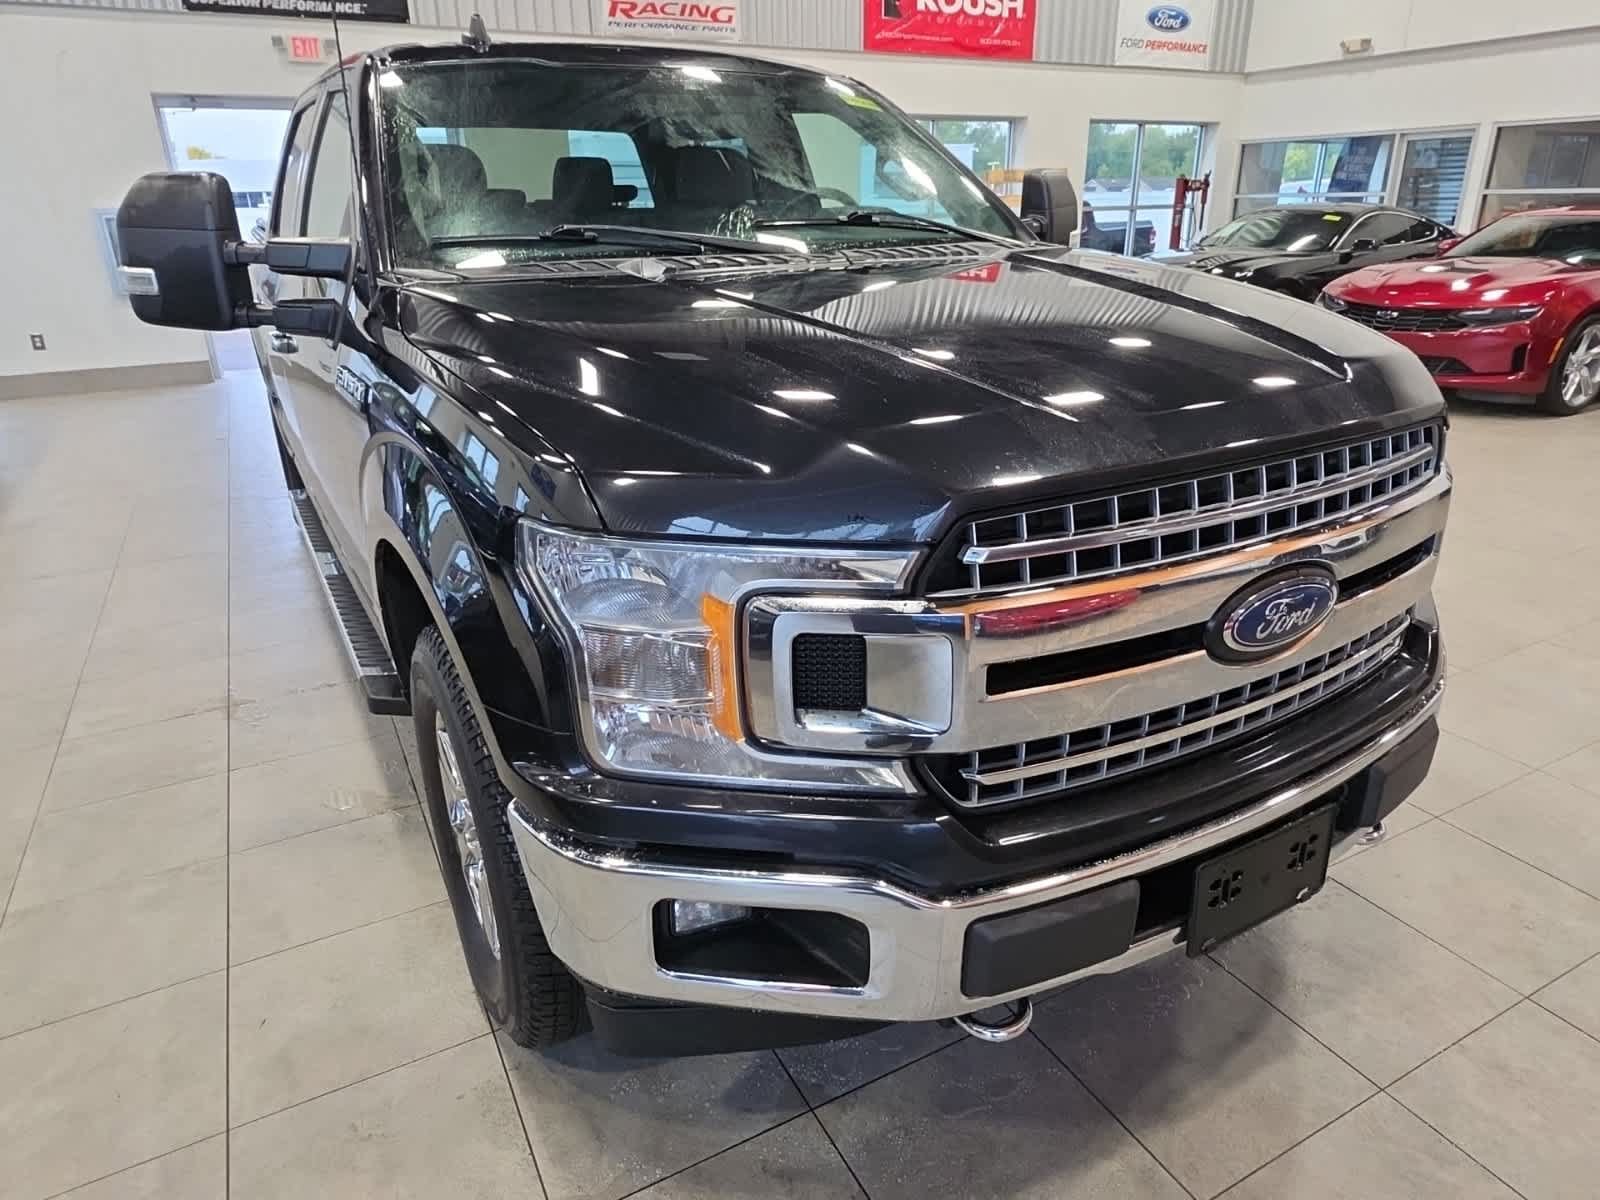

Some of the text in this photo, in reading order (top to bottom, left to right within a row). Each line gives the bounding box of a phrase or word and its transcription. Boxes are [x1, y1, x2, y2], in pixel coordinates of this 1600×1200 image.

[190, 0, 260, 8] PERIOR
[608, 0, 736, 24] RACING
[608, 21, 698, 31] PERFORMANCE
[1154, 8, 1184, 29] Ford
[291, 36, 320, 58] EXIT
[1120, 37, 1208, 54] FORD PERFORMANCE
[1256, 593, 1316, 640] Ford
